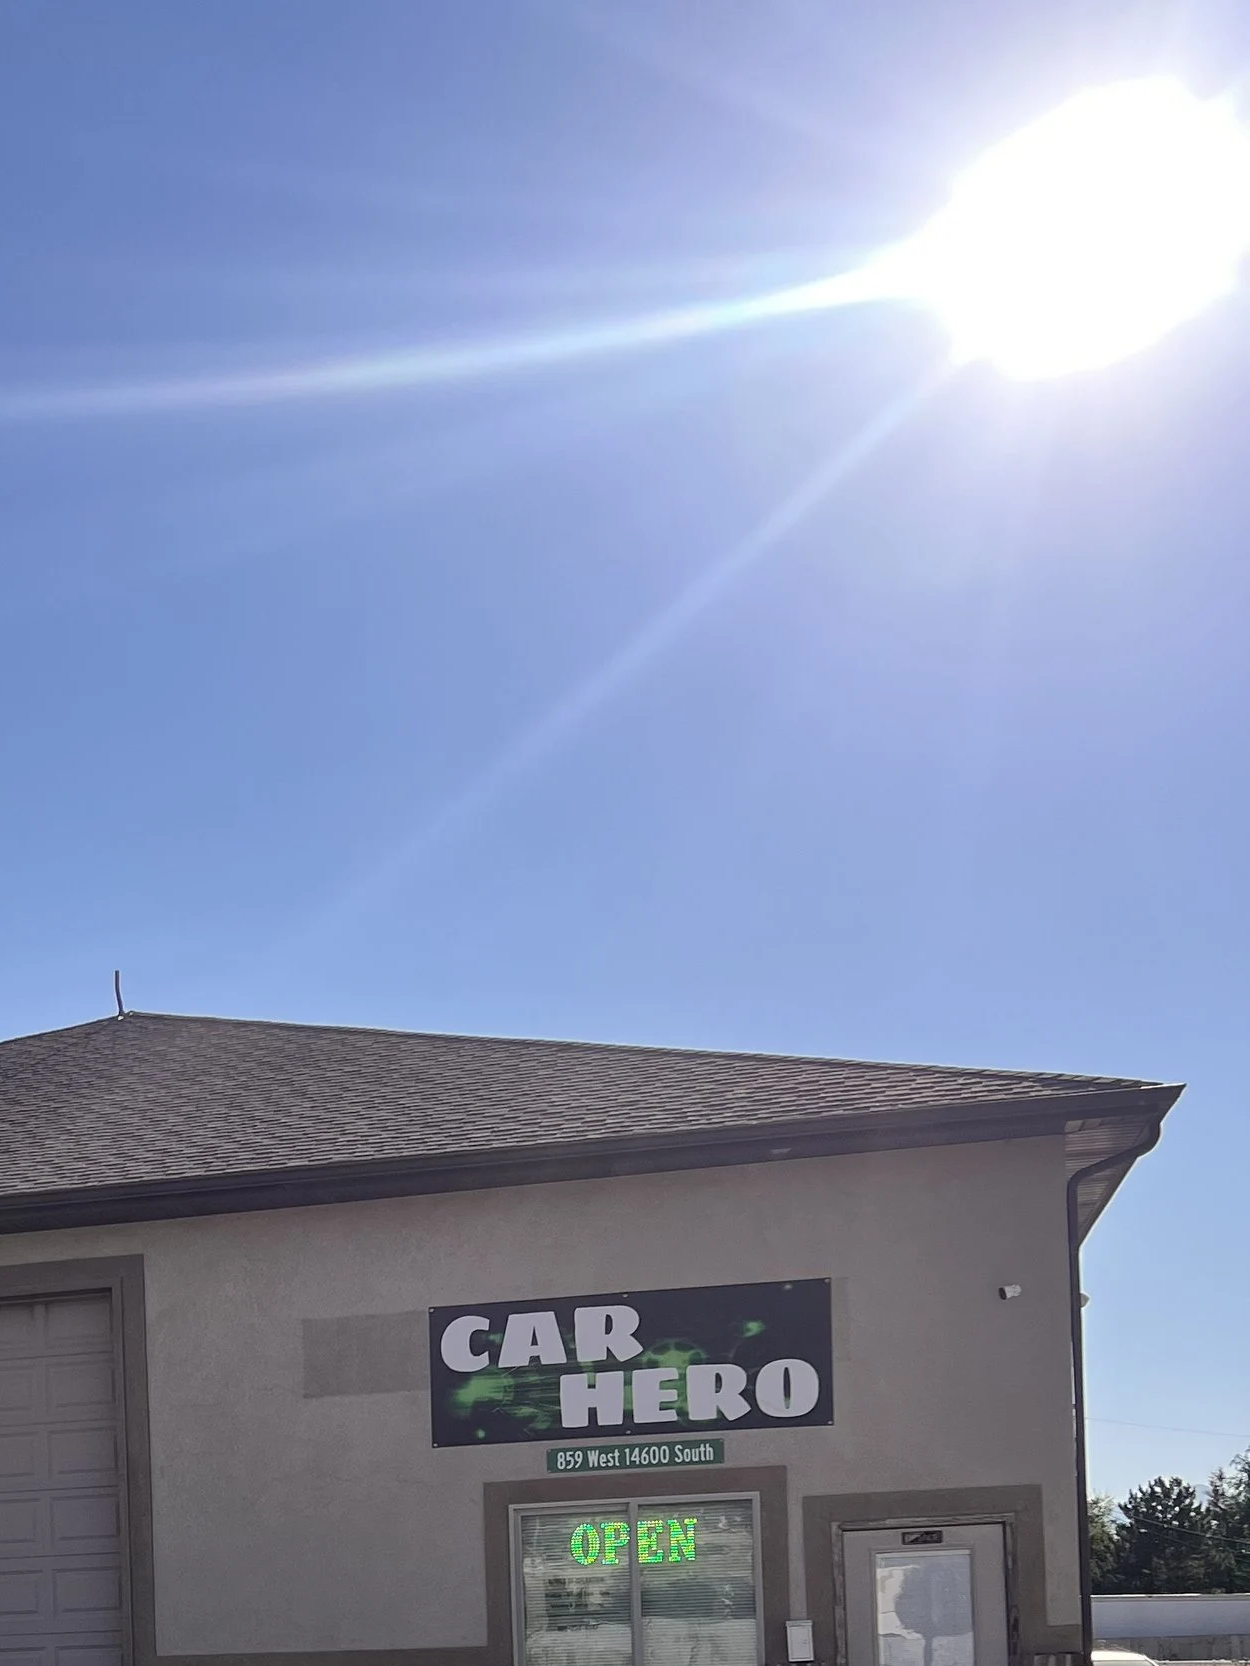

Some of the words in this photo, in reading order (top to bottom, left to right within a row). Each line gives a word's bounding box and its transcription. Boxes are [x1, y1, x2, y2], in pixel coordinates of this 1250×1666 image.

[440, 1305, 644, 1372] CAR
[559, 1358, 819, 1428] HERO
[557, 1451, 583, 1470] 859
[587, 1450, 620, 1468] West
[624, 1445, 669, 1466] 14600
[674, 1443, 714, 1463] South
[570, 1518, 698, 1566] OPEN
